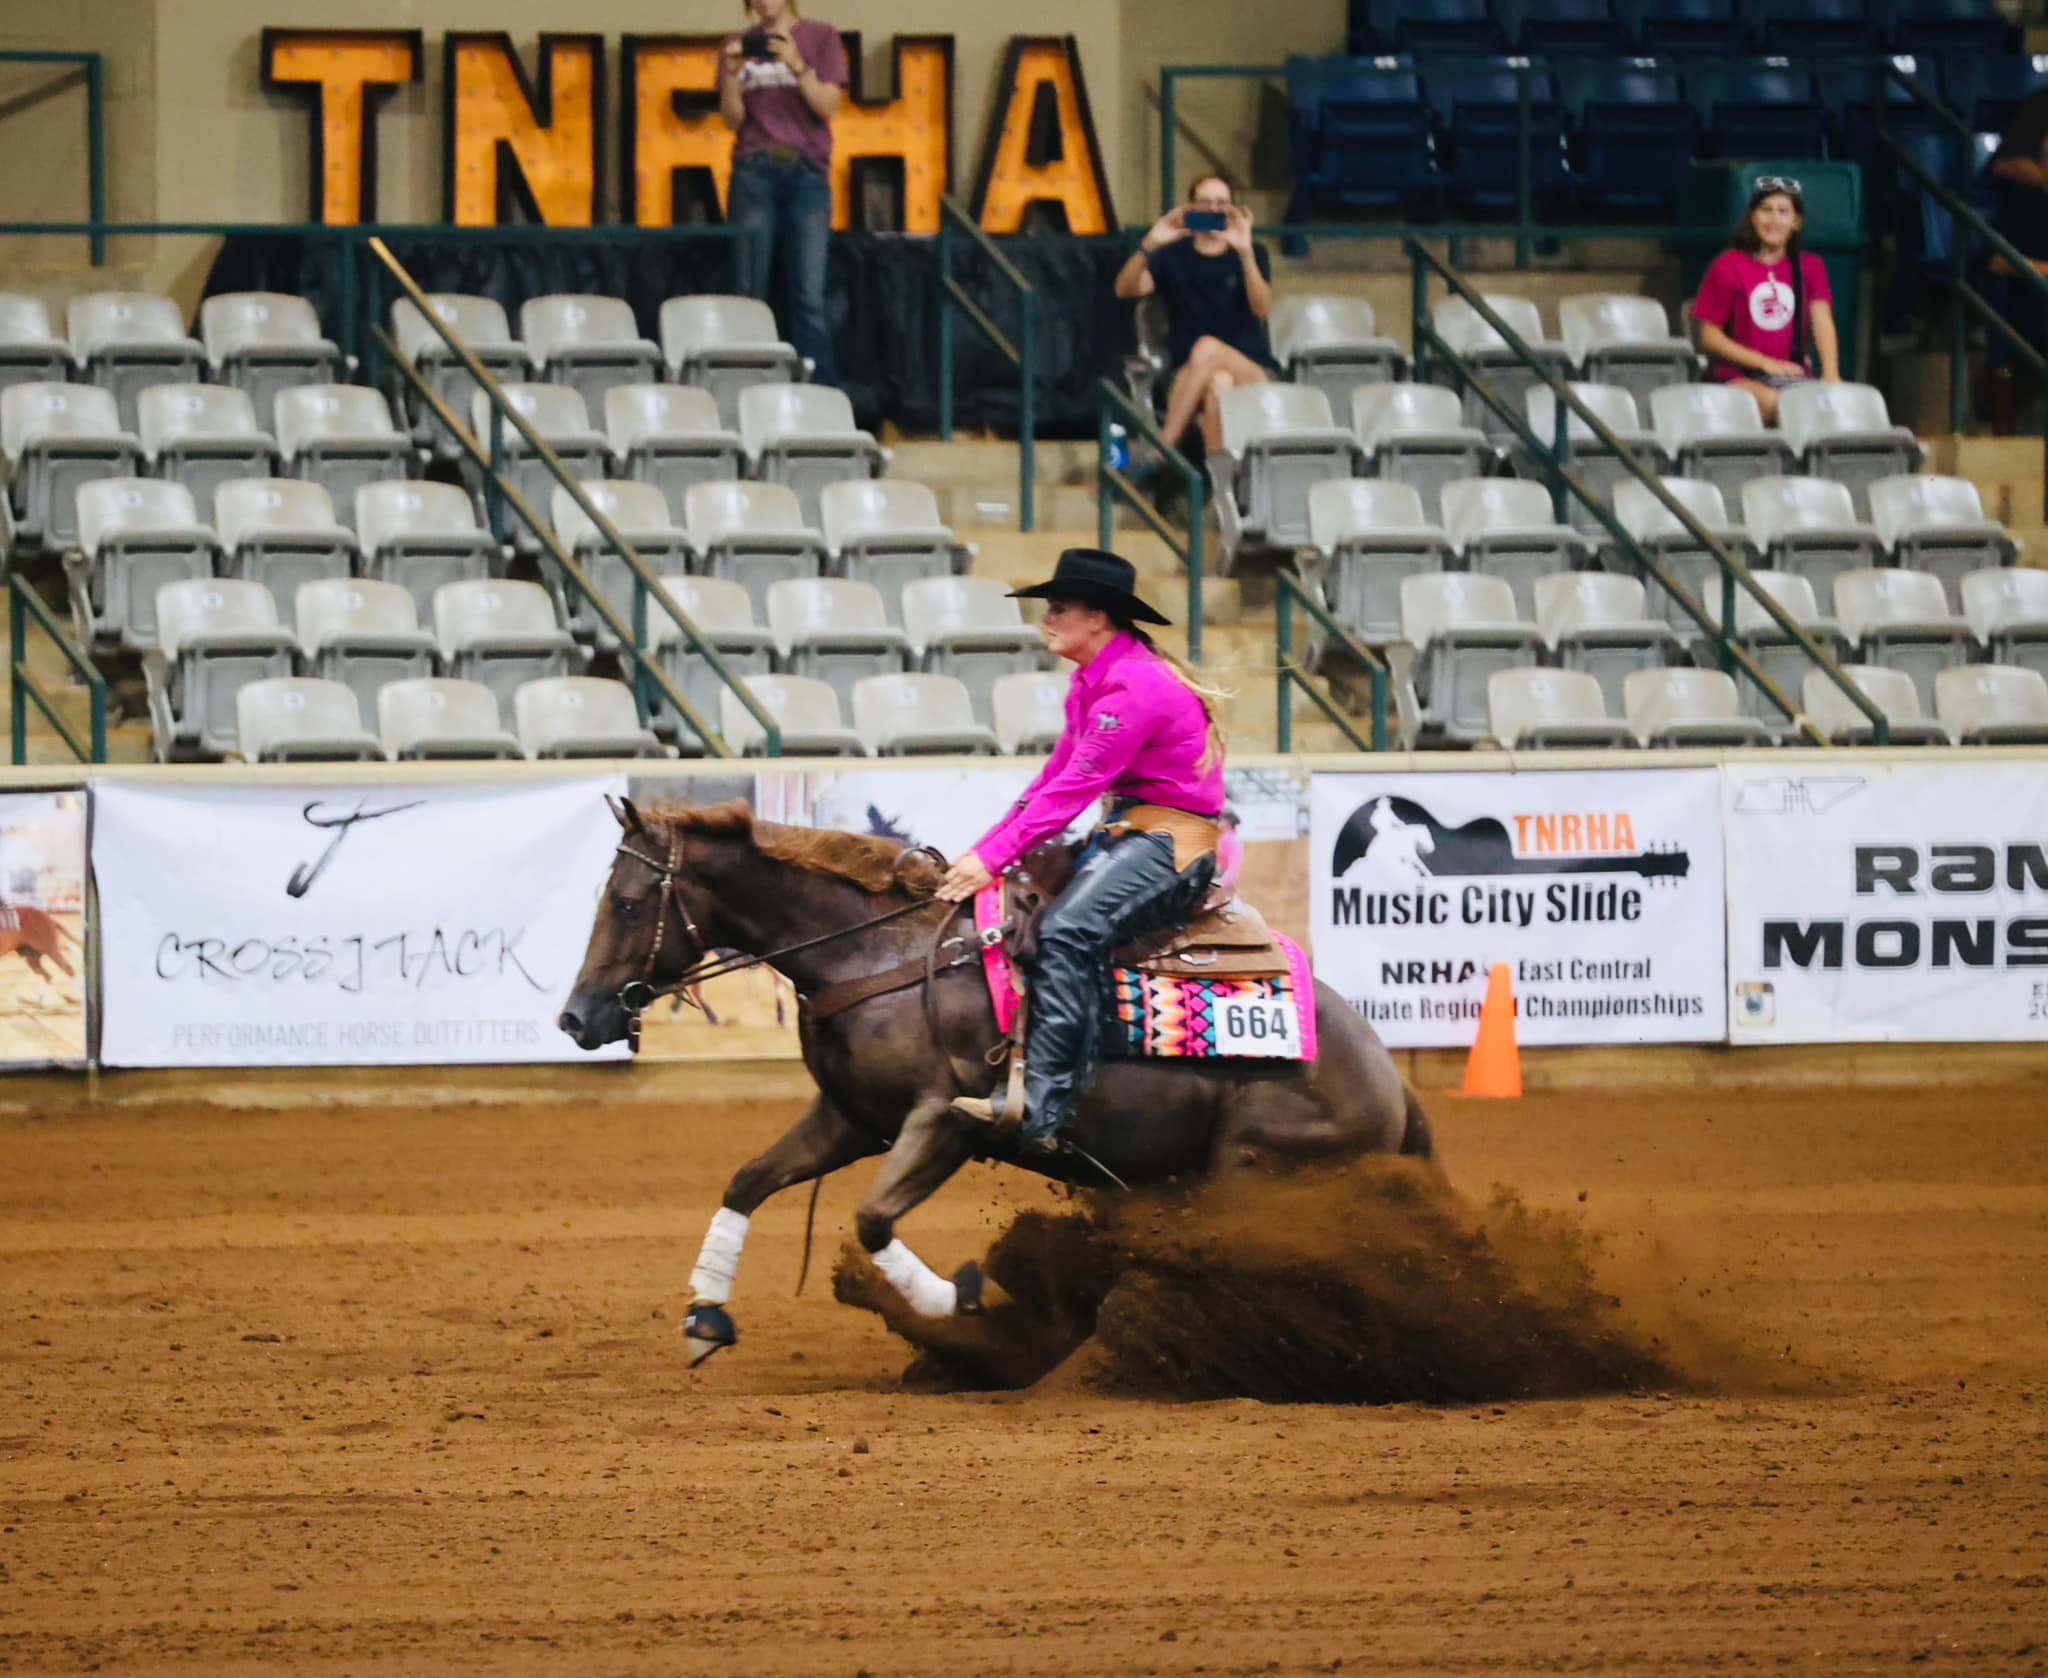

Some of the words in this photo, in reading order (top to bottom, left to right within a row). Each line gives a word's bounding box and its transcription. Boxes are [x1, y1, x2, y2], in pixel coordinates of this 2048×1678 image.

[261, 27, 1118, 236] TNRHA
[1512, 812, 1636, 853] TNRHA
[1332, 885, 1448, 926] Music
[1461, 884, 1534, 927] City
[1546, 882, 1641, 922] Slide
[1518, 958, 1563, 981] East
[1571, 957, 1651, 981] Central
[1226, 1004, 1288, 1040] 664
[1420, 998, 1518, 1021] Regiol
[1526, 994, 1703, 1018] Championships
[172, 1022, 328, 1048] PERFORMANCE
[338, 1021, 410, 1047] HORSE
[414, 1019, 541, 1046] OUTFITTERS
